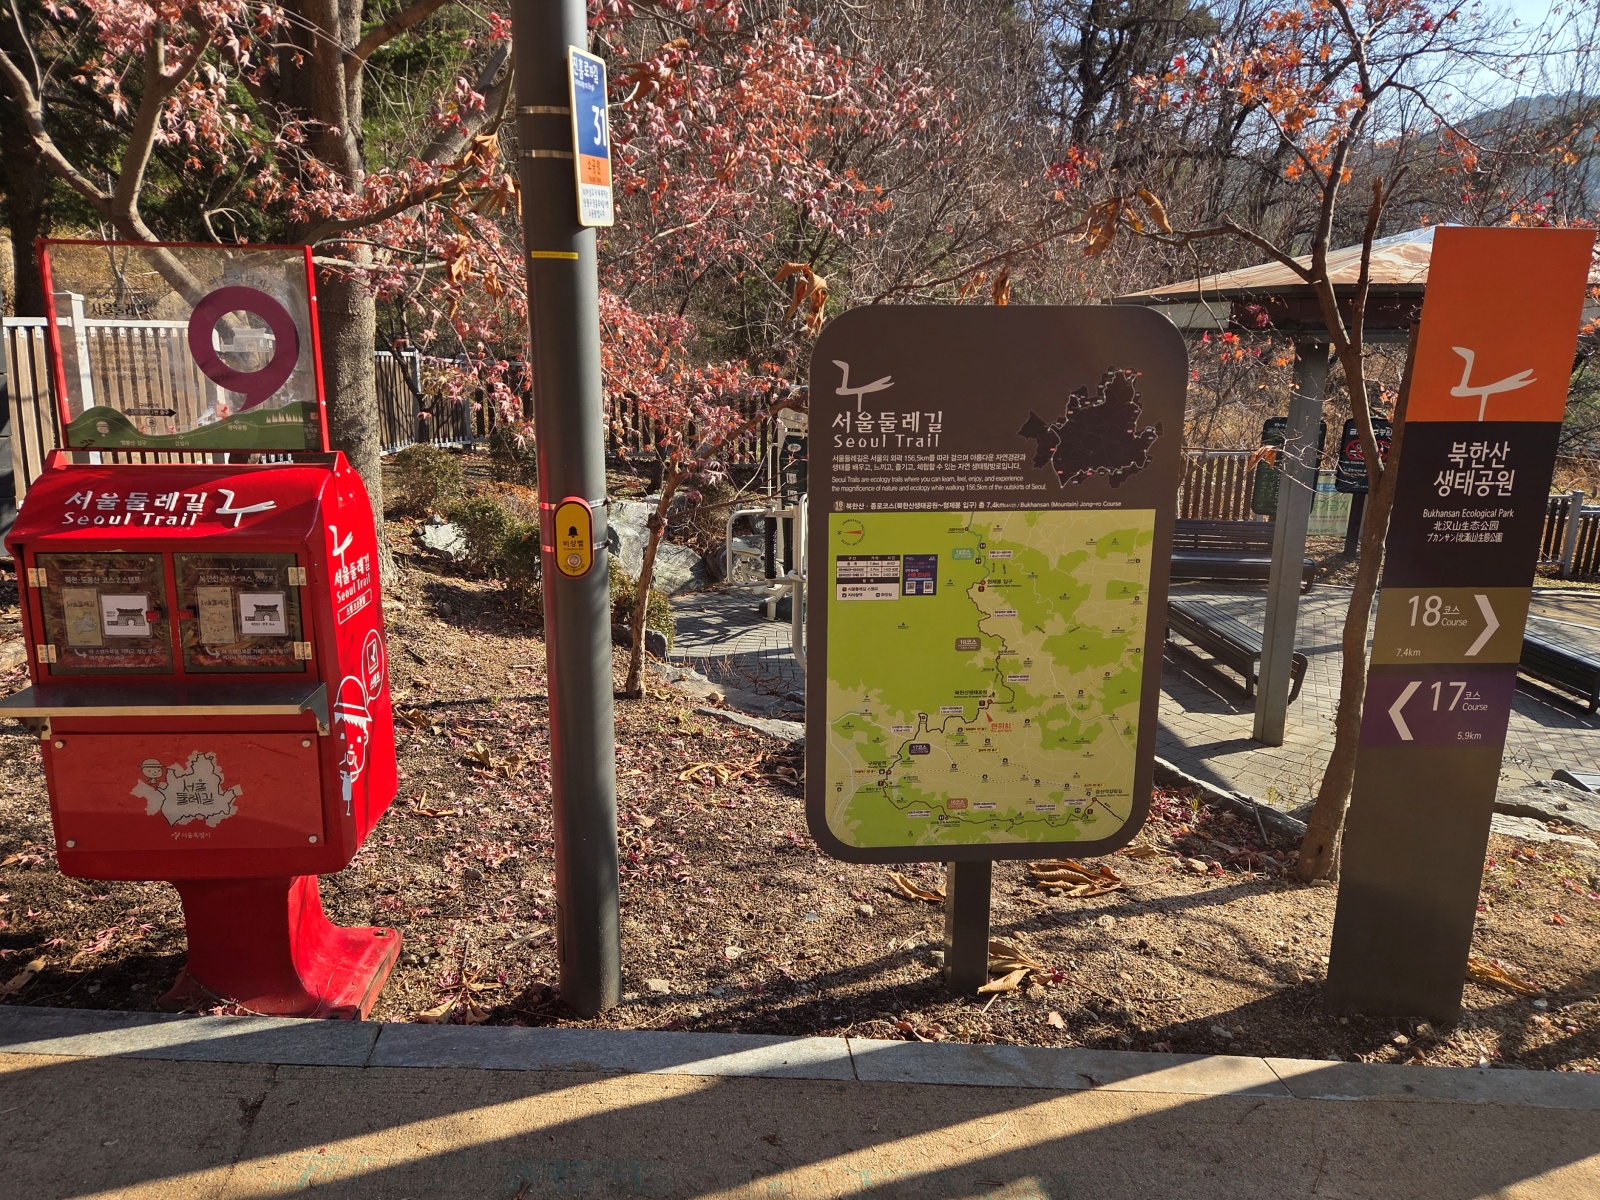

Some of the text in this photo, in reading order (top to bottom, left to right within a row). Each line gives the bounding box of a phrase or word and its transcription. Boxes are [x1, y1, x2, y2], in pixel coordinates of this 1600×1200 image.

[832, 411, 942, 433] 서울둘레길
[834, 434, 938, 447] Seoul Trail
[1448, 440, 1510, 469] 북한산
[1433, 470, 1515, 497] 생태공원
[64, 490, 208, 511] 서울둘레길
[62, 512, 198, 526] Seoul Trail
[1423, 509, 1514, 519] Bukhansan Ecological Park
[1434, 520, 1499, 531] 北汉山生态公园
[334, 553, 370, 588] 서울둘레길
[336, 572, 371, 604] Seoul Trail
[1408, 595, 1460, 627] 18 코스
[1441, 618, 1467, 627] Course
[1396, 648, 1421, 657] 7.4km
[1430, 681, 1481, 711] 17 코스
[1462, 703, 1488, 711] Course
[1457, 732, 1482, 740] 5.9km
[183, 779, 207, 792] 서울
[176, 793, 214, 805] 둘레길
